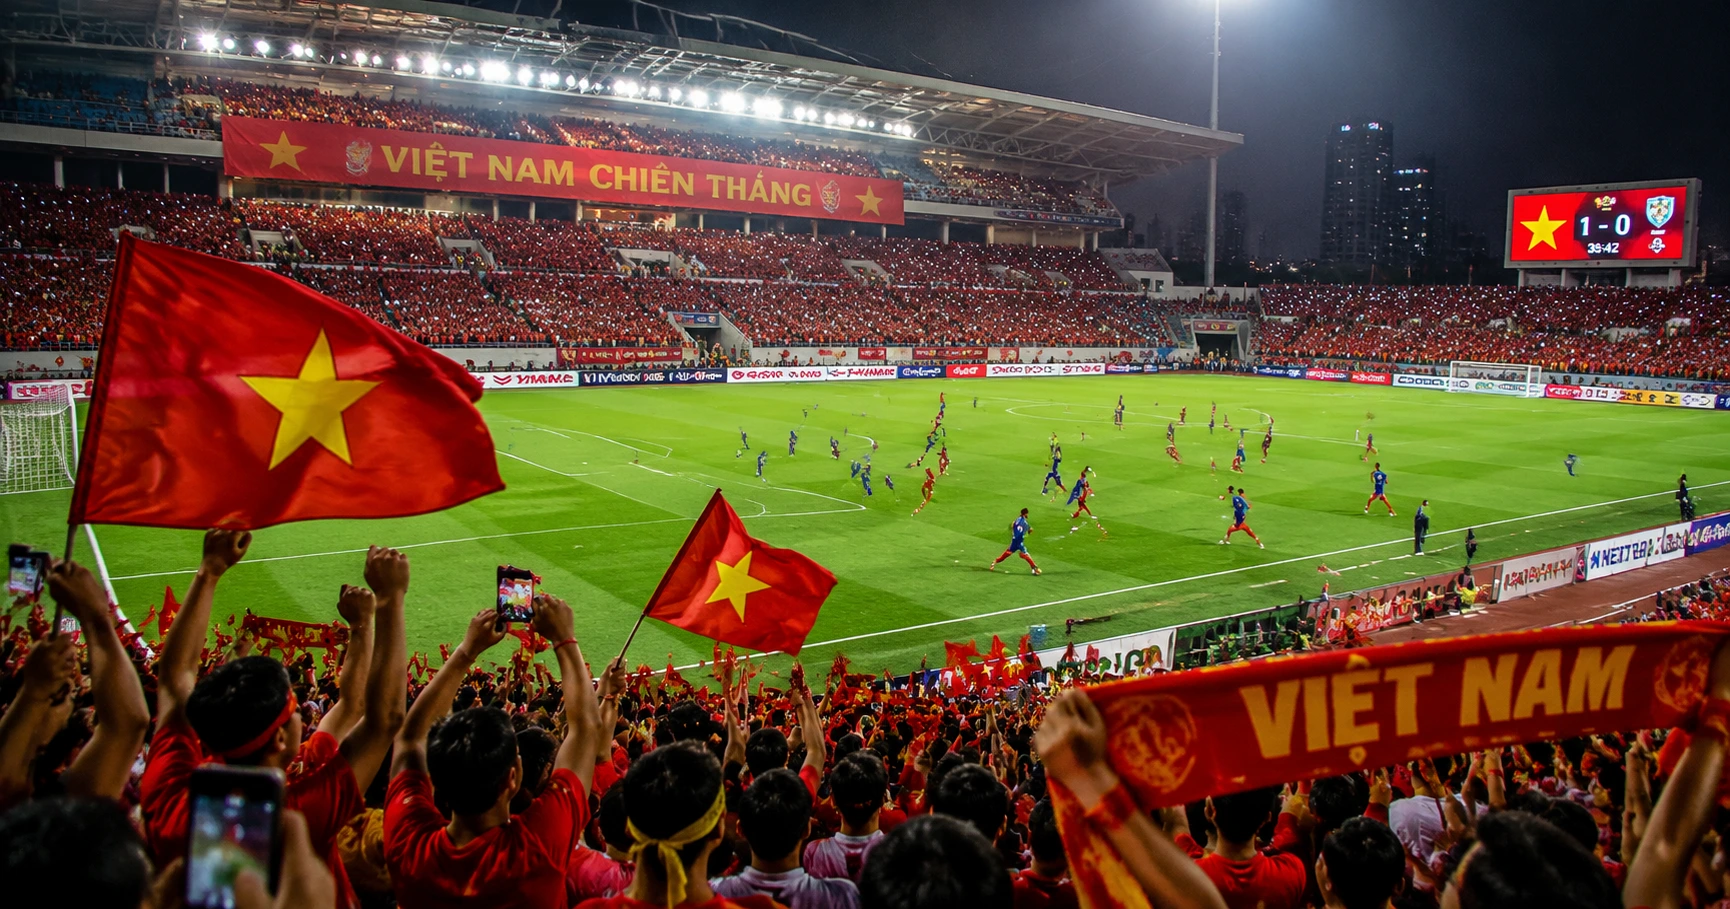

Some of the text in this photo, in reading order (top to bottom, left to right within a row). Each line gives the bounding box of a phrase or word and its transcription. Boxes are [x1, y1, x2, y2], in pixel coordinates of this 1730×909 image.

[381, 141, 473, 183] VIỆT
[488, 154, 575, 187] NAM
[1580, 216, 1590, 236] 1
[1615, 213, 1631, 236] 0
[1239, 645, 1637, 765] VIỆT NAM
